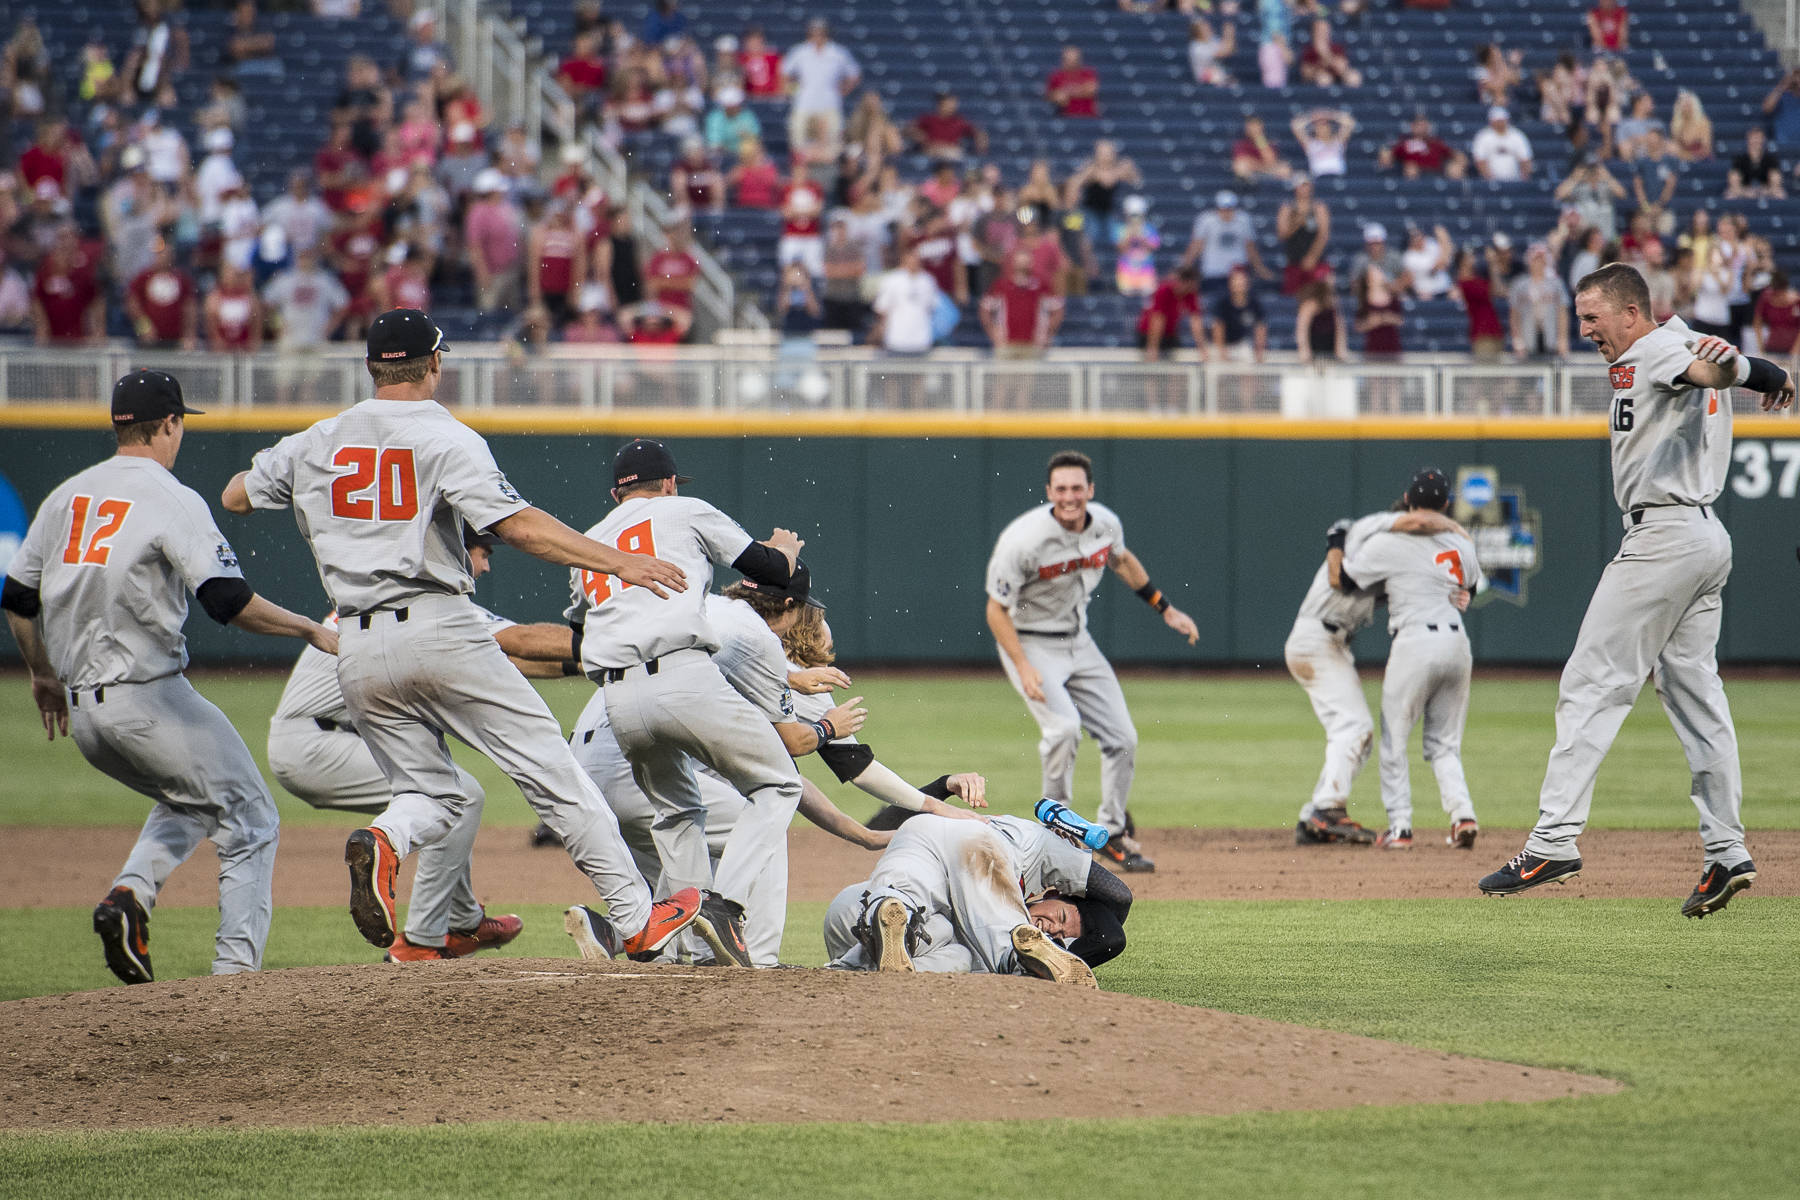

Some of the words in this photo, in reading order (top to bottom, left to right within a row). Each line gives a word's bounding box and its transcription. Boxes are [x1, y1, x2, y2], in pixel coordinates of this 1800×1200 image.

[381, 351, 407, 359] BEAVERS
[331, 445, 419, 522] 20
[1732, 440, 1800, 498] 37
[63, 494, 134, 567] 12
[1434, 548, 1463, 586] 3
